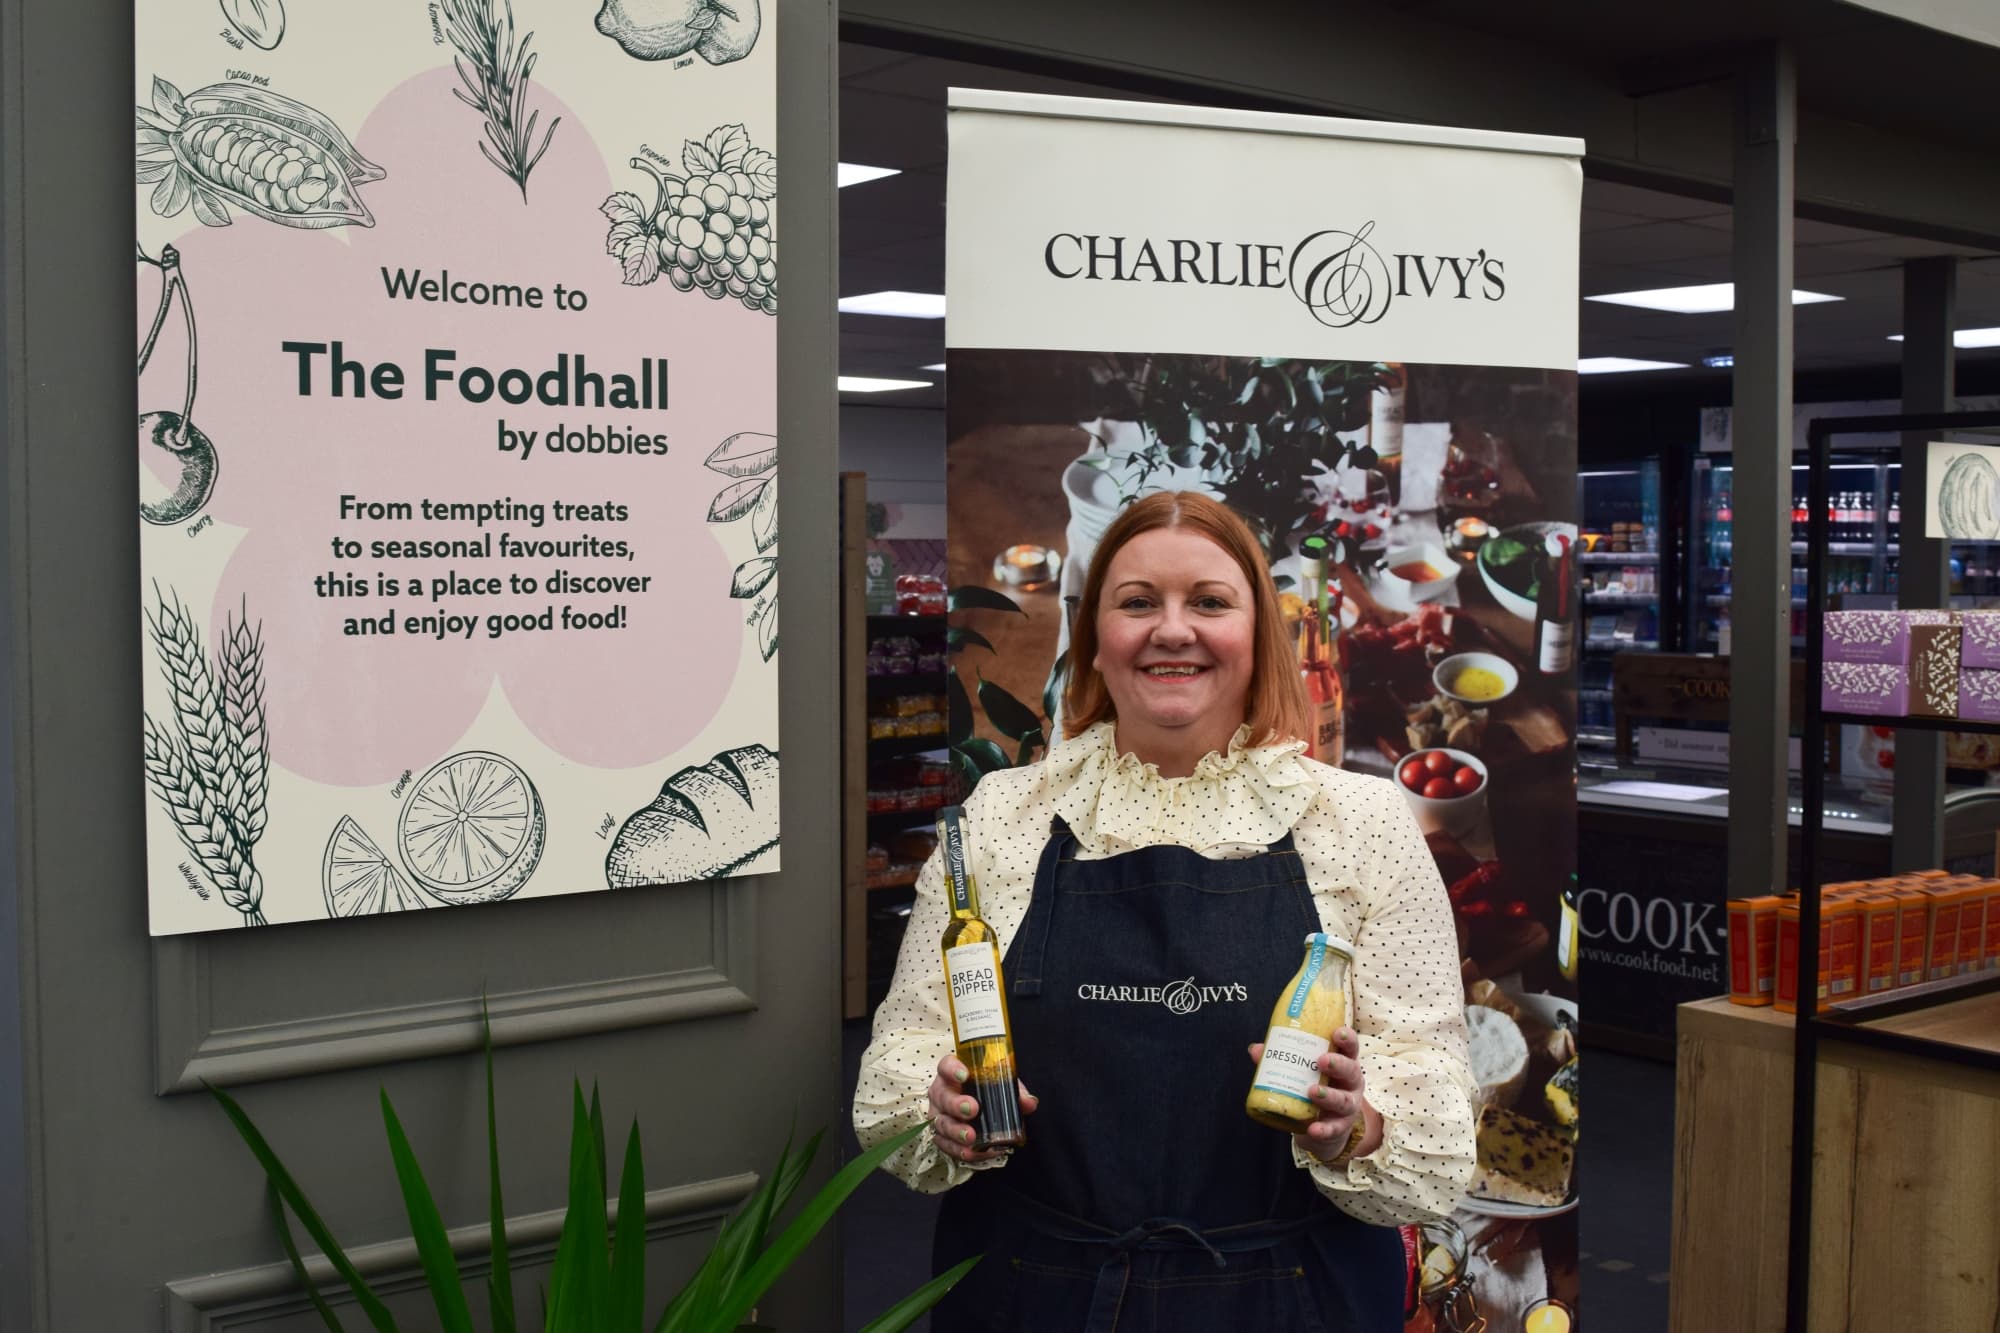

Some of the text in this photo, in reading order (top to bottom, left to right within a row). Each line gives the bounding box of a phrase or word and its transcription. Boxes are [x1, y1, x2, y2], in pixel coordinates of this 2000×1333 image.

[219, 28, 245, 50] Basil
[1045, 233, 1287, 289] CHARLIE
[1393, 249, 1505, 301] IVY'S
[381, 266, 588, 312] Welcome to
[282, 341, 669, 410] The Foodhall
[498, 418, 669, 460] by dobbies
[340, 495, 629, 527] From tempting treats
[331, 532, 635, 562] to seasonal favourites,
[314, 568, 652, 603] this is a place to discover
[343, 604, 627, 641] and enjoy good food!
[595, 812, 616, 840] Loaf
[953, 861, 966, 901] CHARLIE
[951, 967, 993, 986] BREAD
[953, 980, 996, 998] DIPPER
[1077, 984, 1162, 1003] CHARLIE
[1201, 982, 1248, 1003] IVY'S
[1265, 1049, 1319, 1072] DRESSING
